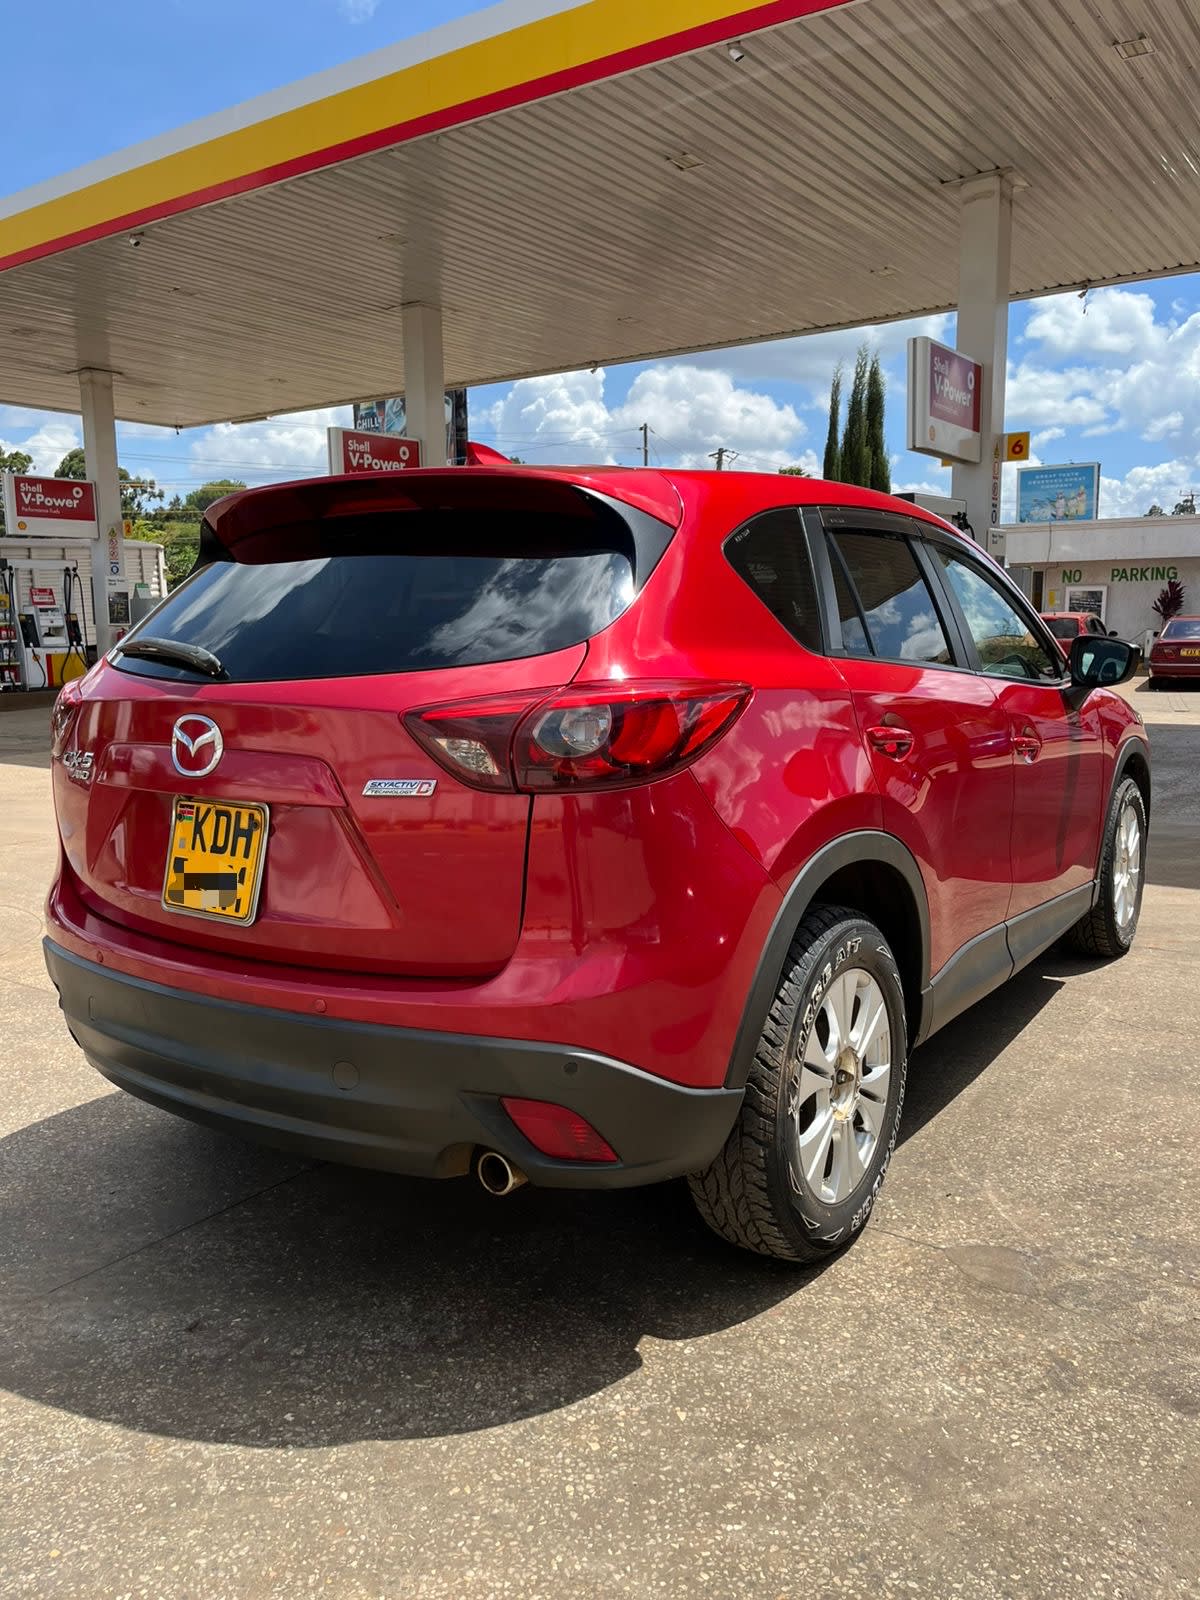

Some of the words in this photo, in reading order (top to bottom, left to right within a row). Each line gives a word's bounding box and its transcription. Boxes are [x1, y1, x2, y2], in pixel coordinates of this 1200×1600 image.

[934, 356, 949, 376] Shell
[934, 373, 971, 407] V-Power
[356, 417, 379, 430] CHILL
[348, 439, 370, 452] Shell
[1011, 439, 1024, 455] 6
[349, 452, 406, 471] V-Power
[20, 482, 43, 493] Shell
[21, 492, 80, 509] V-Power
[1062, 569, 1082, 584] NO
[1111, 566, 1178, 582] PARKING
[63, 751, 94, 768] CX-5
[191, 806, 255, 859] KDH
